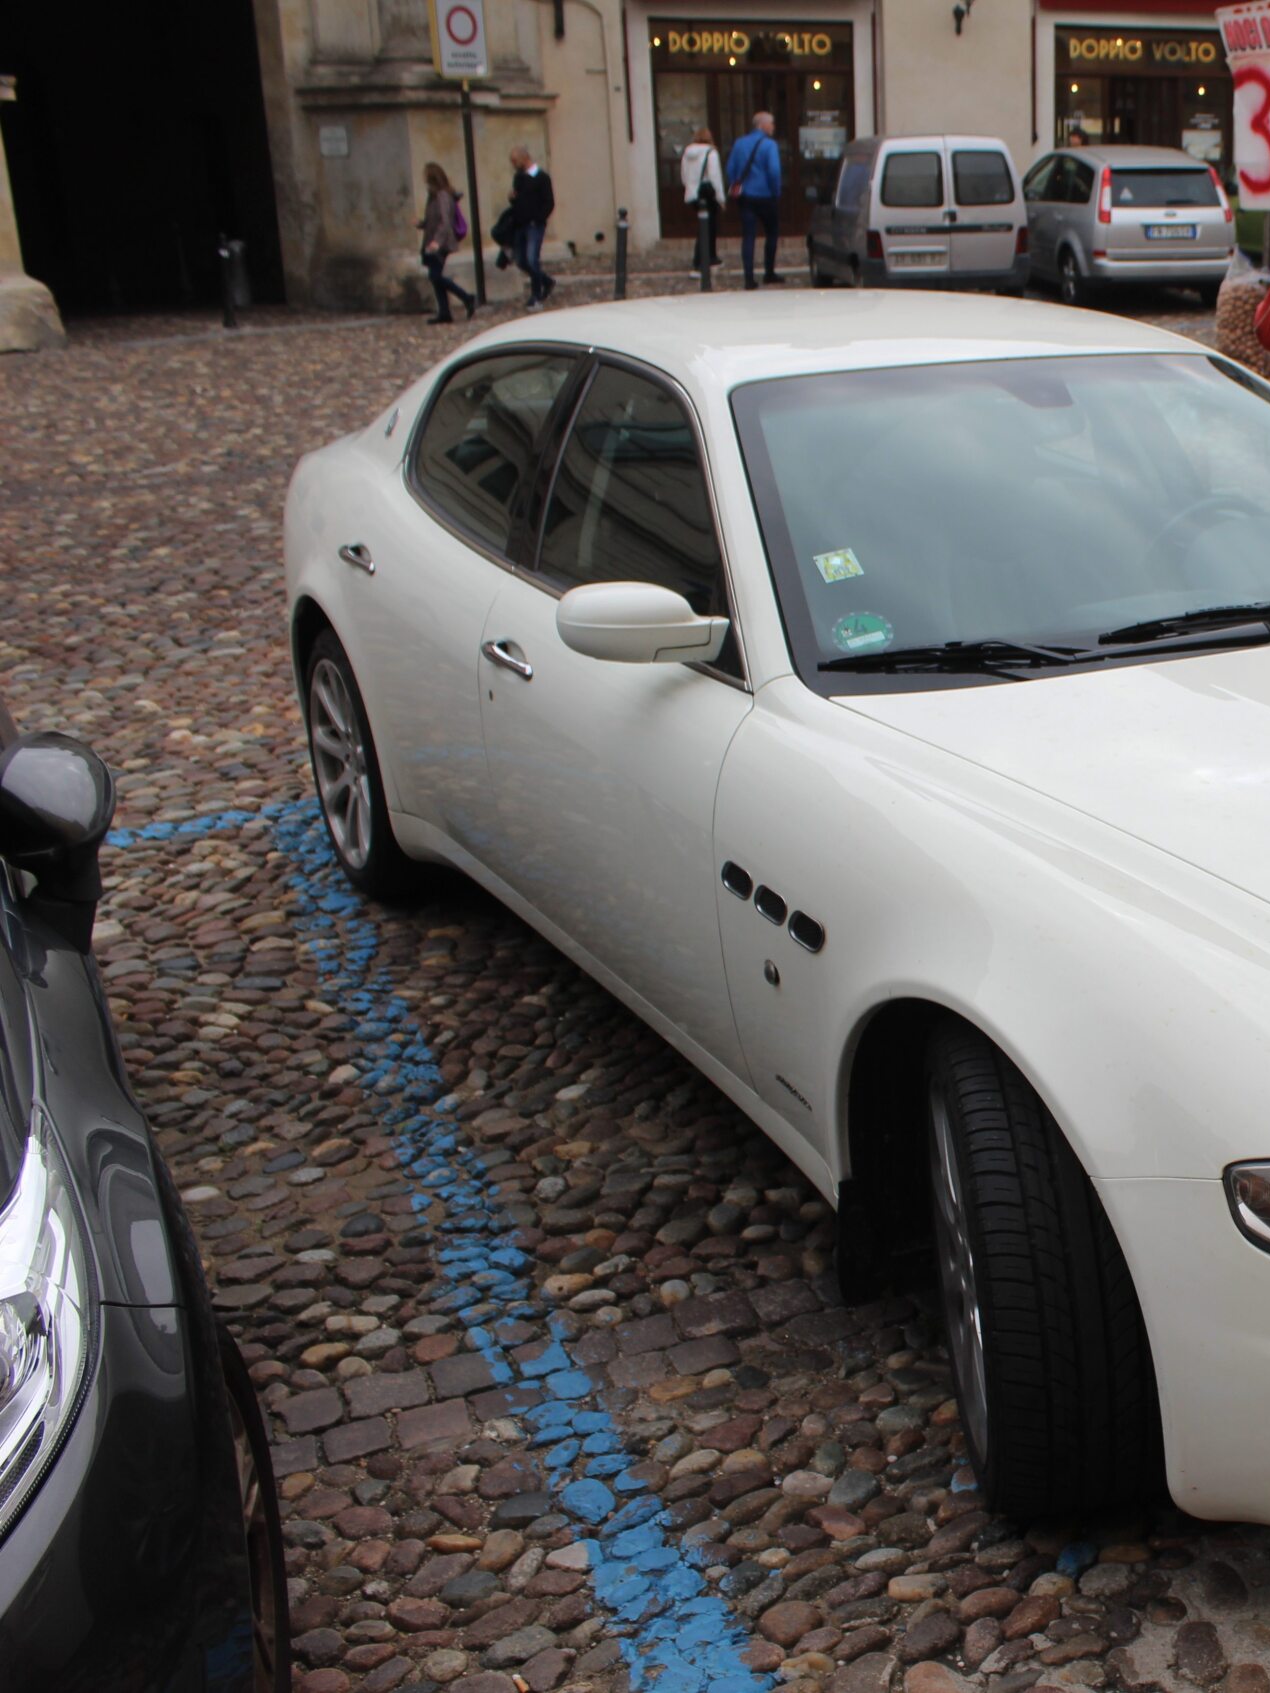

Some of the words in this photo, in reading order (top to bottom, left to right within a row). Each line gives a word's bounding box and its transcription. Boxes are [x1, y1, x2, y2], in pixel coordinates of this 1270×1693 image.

[668, 31, 750, 54] DOPPIO
[758, 31, 832, 55] OLTO
[1069, 37, 1143, 61] DOPPIO
[1152, 41, 1216, 62] VOLTO
